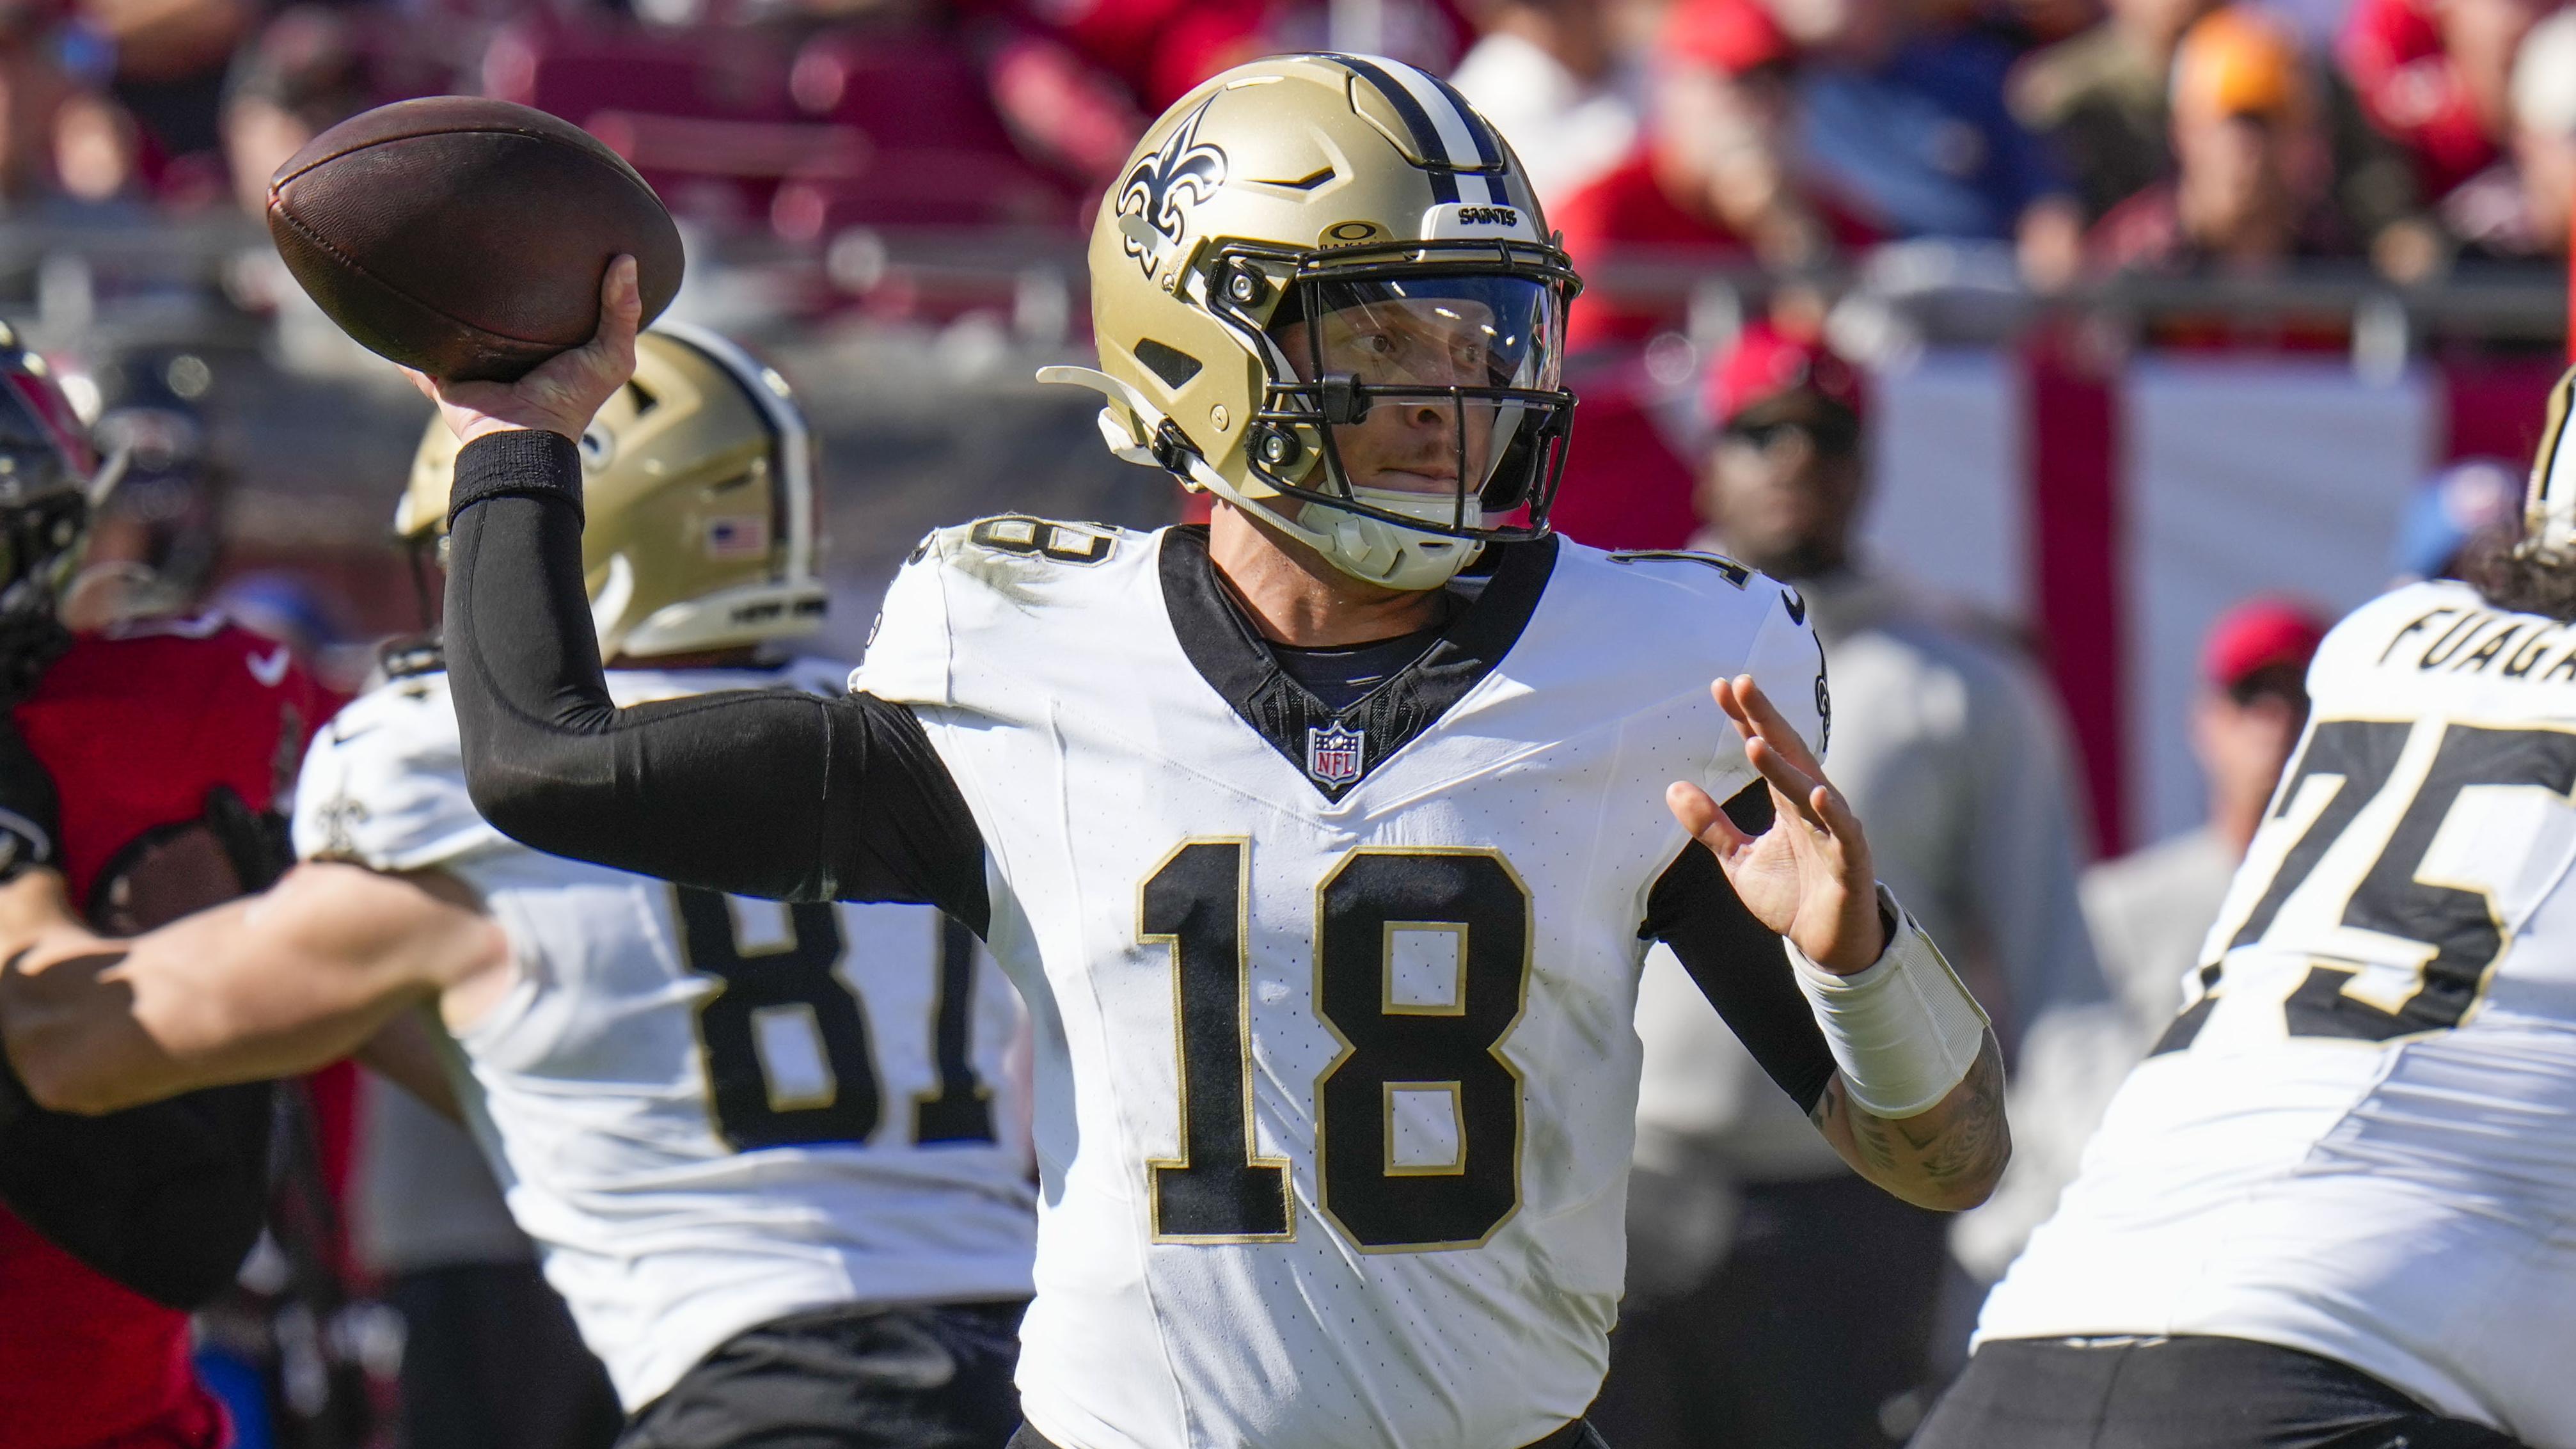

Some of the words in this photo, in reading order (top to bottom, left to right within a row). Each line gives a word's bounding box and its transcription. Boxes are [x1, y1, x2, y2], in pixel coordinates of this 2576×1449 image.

[1458, 207, 1517, 227] SAINTS
[1317, 752, 1353, 777] NFL
[2144, 716, 2576, 1059] 75
[670, 882, 998, 1153] 81
[1135, 834, 1534, 1255] 18
